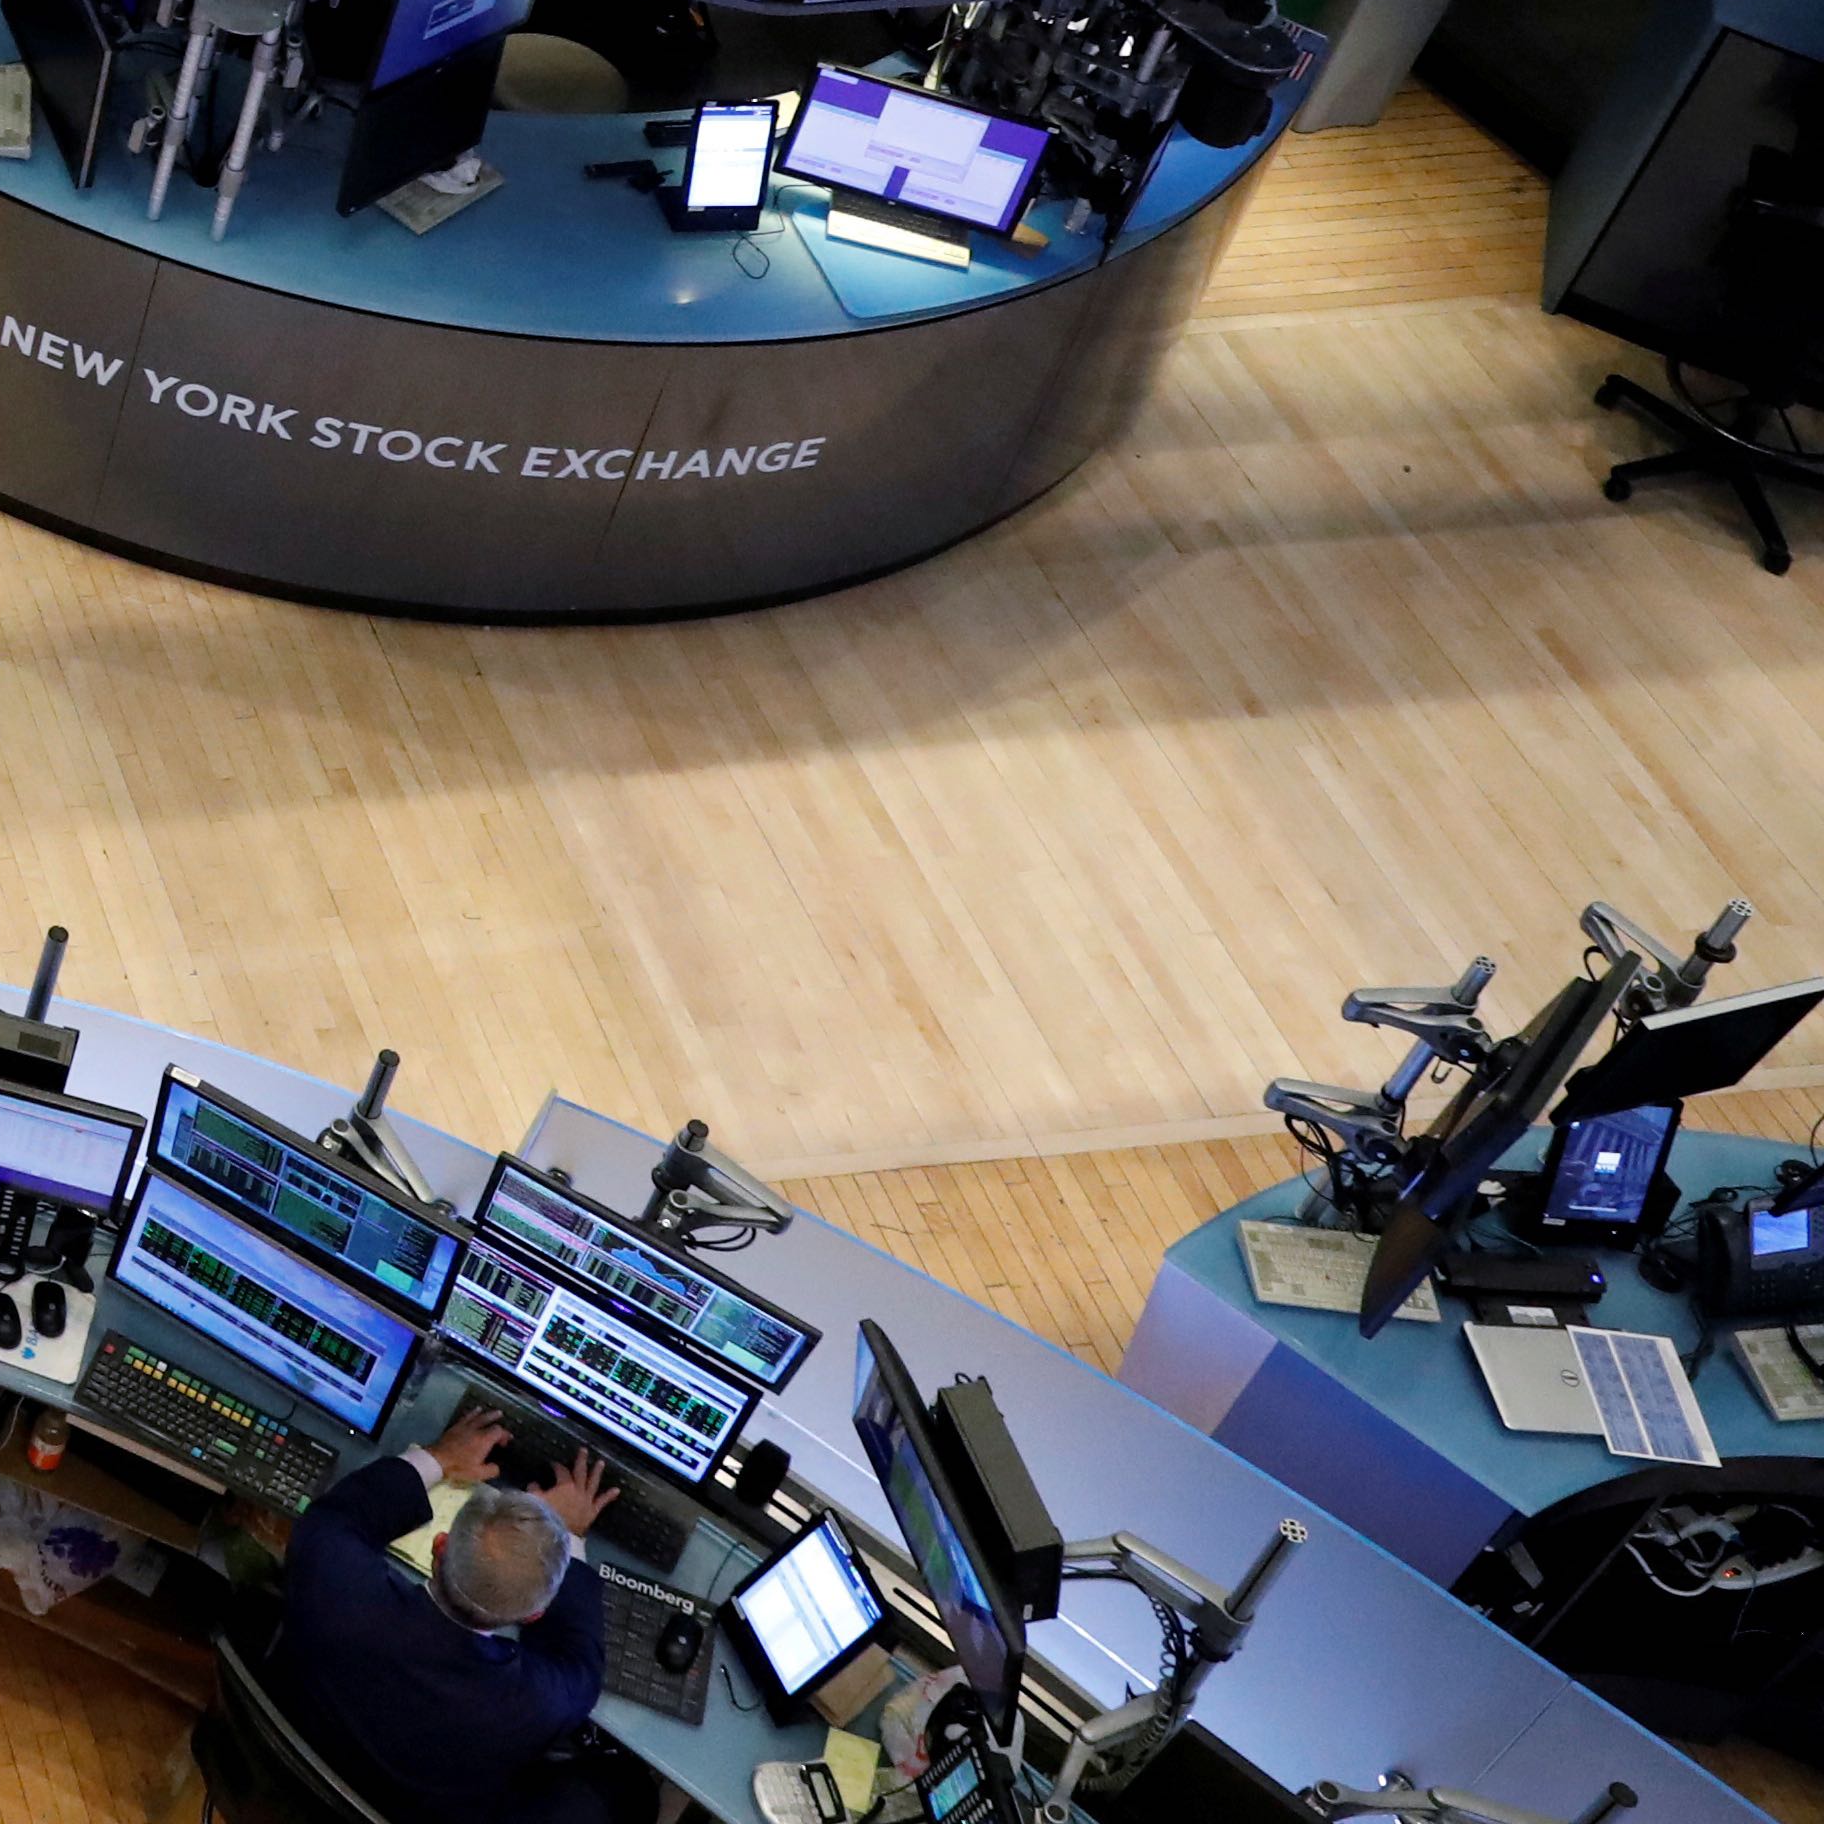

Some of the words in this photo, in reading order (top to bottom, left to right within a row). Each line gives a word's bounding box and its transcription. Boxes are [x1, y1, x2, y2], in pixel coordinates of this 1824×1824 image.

[142, 369, 300, 442] YORK
[309, 415, 510, 477] STOCK
[520, 437, 827, 482] EXCHANGE
[599, 1562, 696, 1616] Bloomberg
